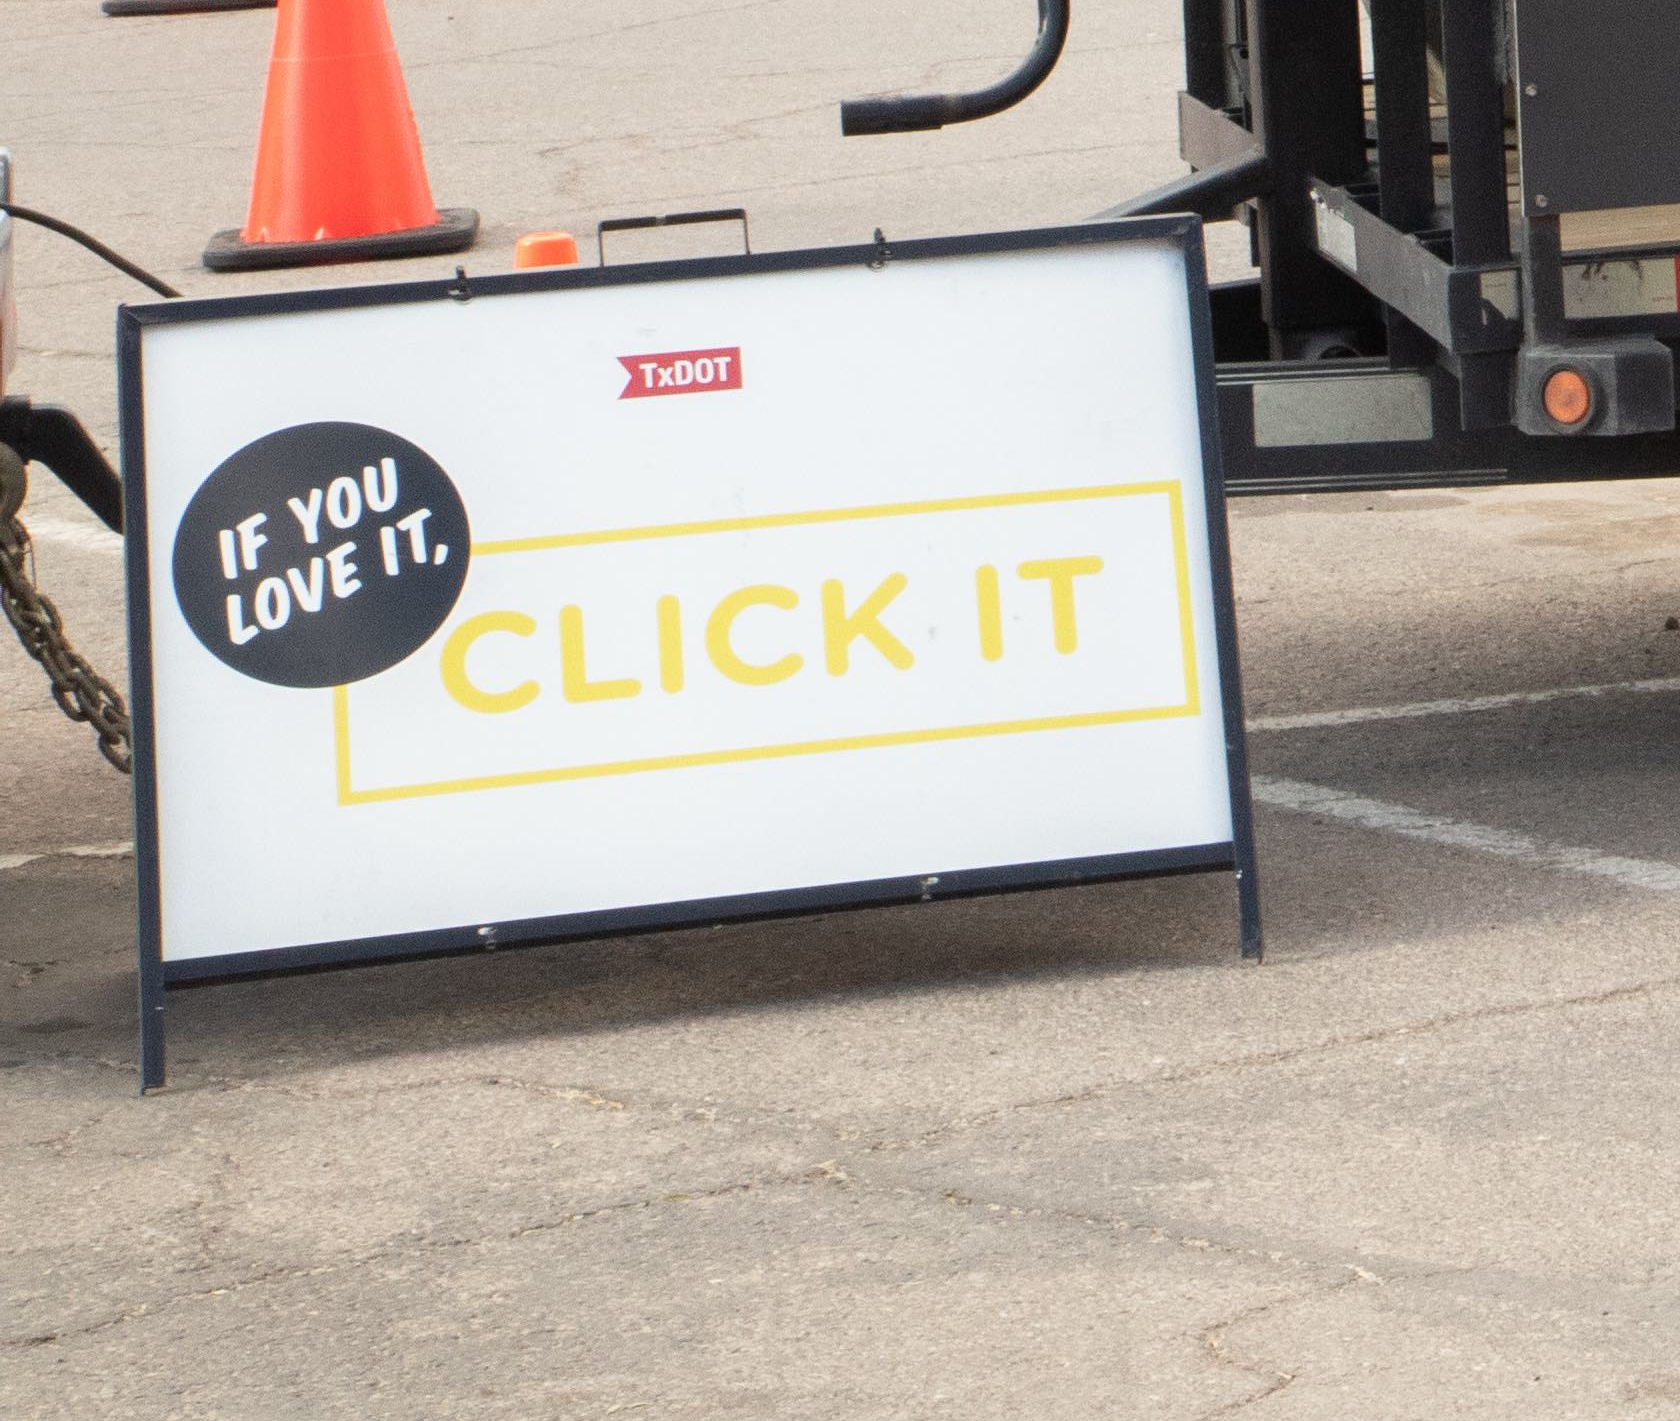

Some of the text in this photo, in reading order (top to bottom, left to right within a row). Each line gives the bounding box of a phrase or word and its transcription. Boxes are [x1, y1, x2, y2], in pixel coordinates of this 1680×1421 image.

[639, 357, 731, 388] TxDOT
[219, 457, 398, 580] IF YOU
[226, 508, 448, 645] LOVE IT,
[441, 557, 1103, 713] CLICK IT
